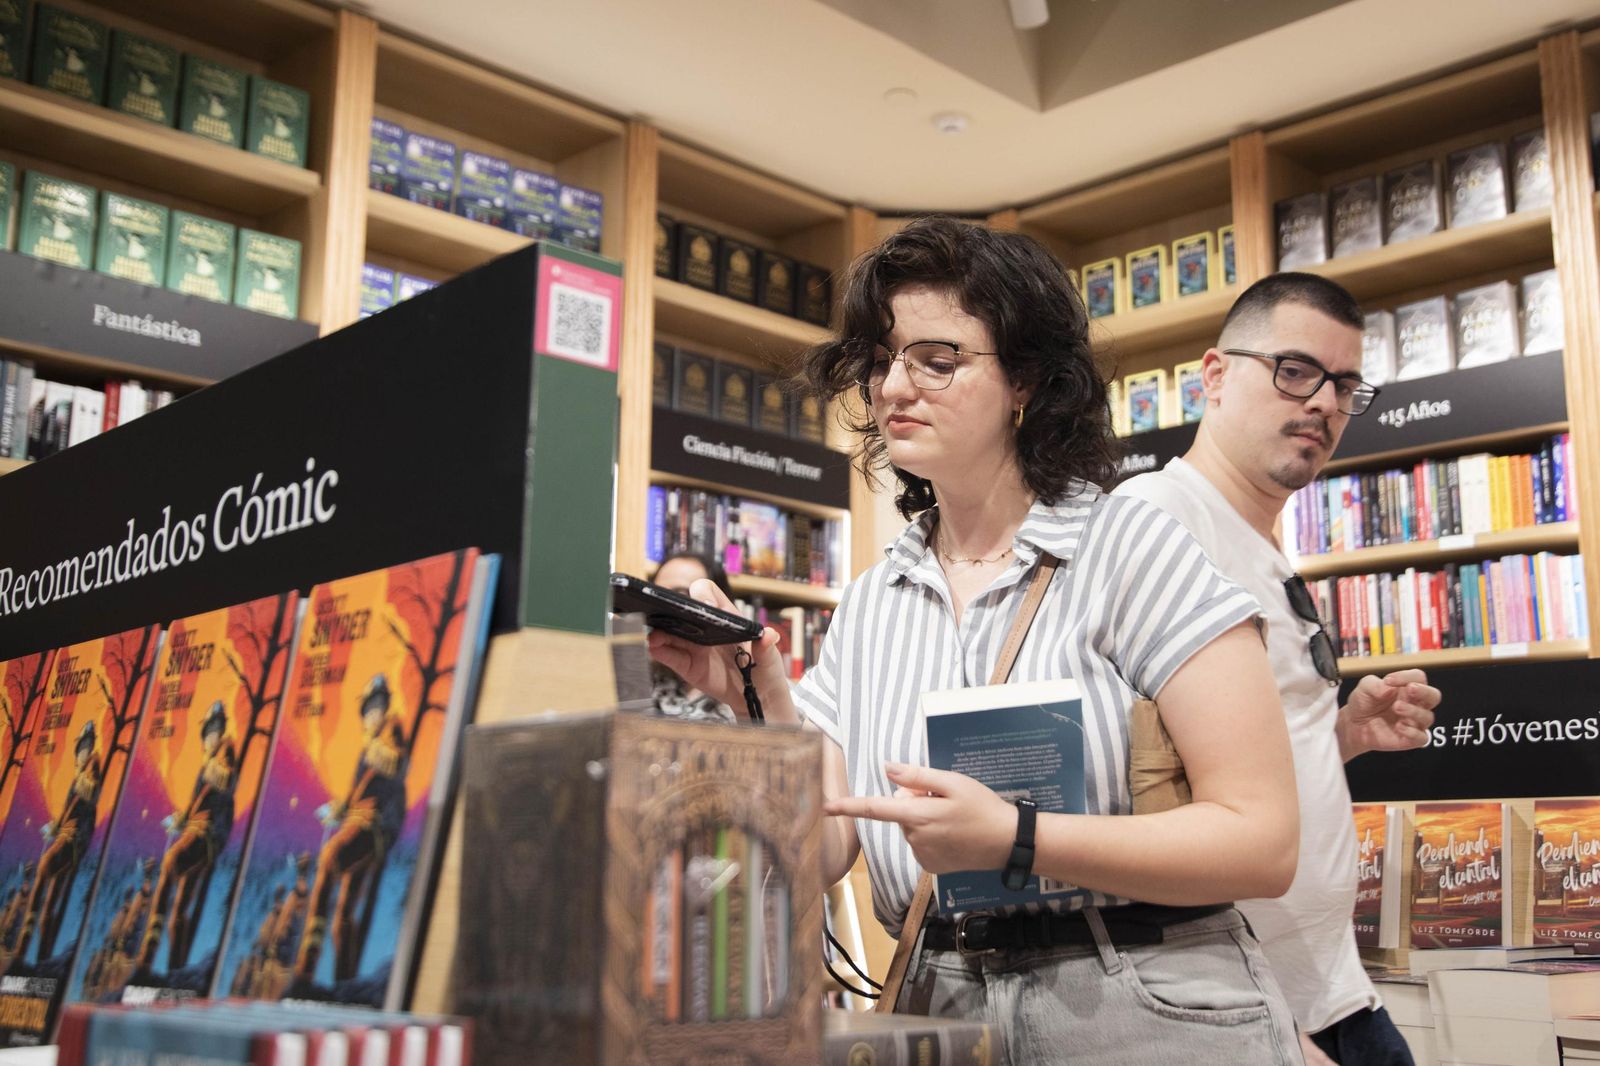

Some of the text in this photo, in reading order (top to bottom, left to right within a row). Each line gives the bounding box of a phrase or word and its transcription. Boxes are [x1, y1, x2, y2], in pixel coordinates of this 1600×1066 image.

[93, 303, 201, 347] Fantástica
[1378, 400, 1451, 428] +15 Años
[683, 435, 731, 462] Ciencia
[732, 445, 777, 473] Ficción
[783, 457, 822, 481] Terror
[0, 457, 338, 616] Recomendados Cómic
[310, 607, 371, 648] SNYDER
[165, 642, 215, 677] SNYDER
[51, 668, 92, 699] SNYDER
[1452, 712, 1600, 746] #Jóvenes
[1416, 827, 1489, 870] Perdiendo
[1537, 831, 1600, 871] Perdien
[1439, 855, 1499, 890] el control
[1563, 866, 1580, 891] el
[1439, 926, 1496, 937] TOMFORDE
[1541, 929, 1600, 939] LIZ TOMFO
